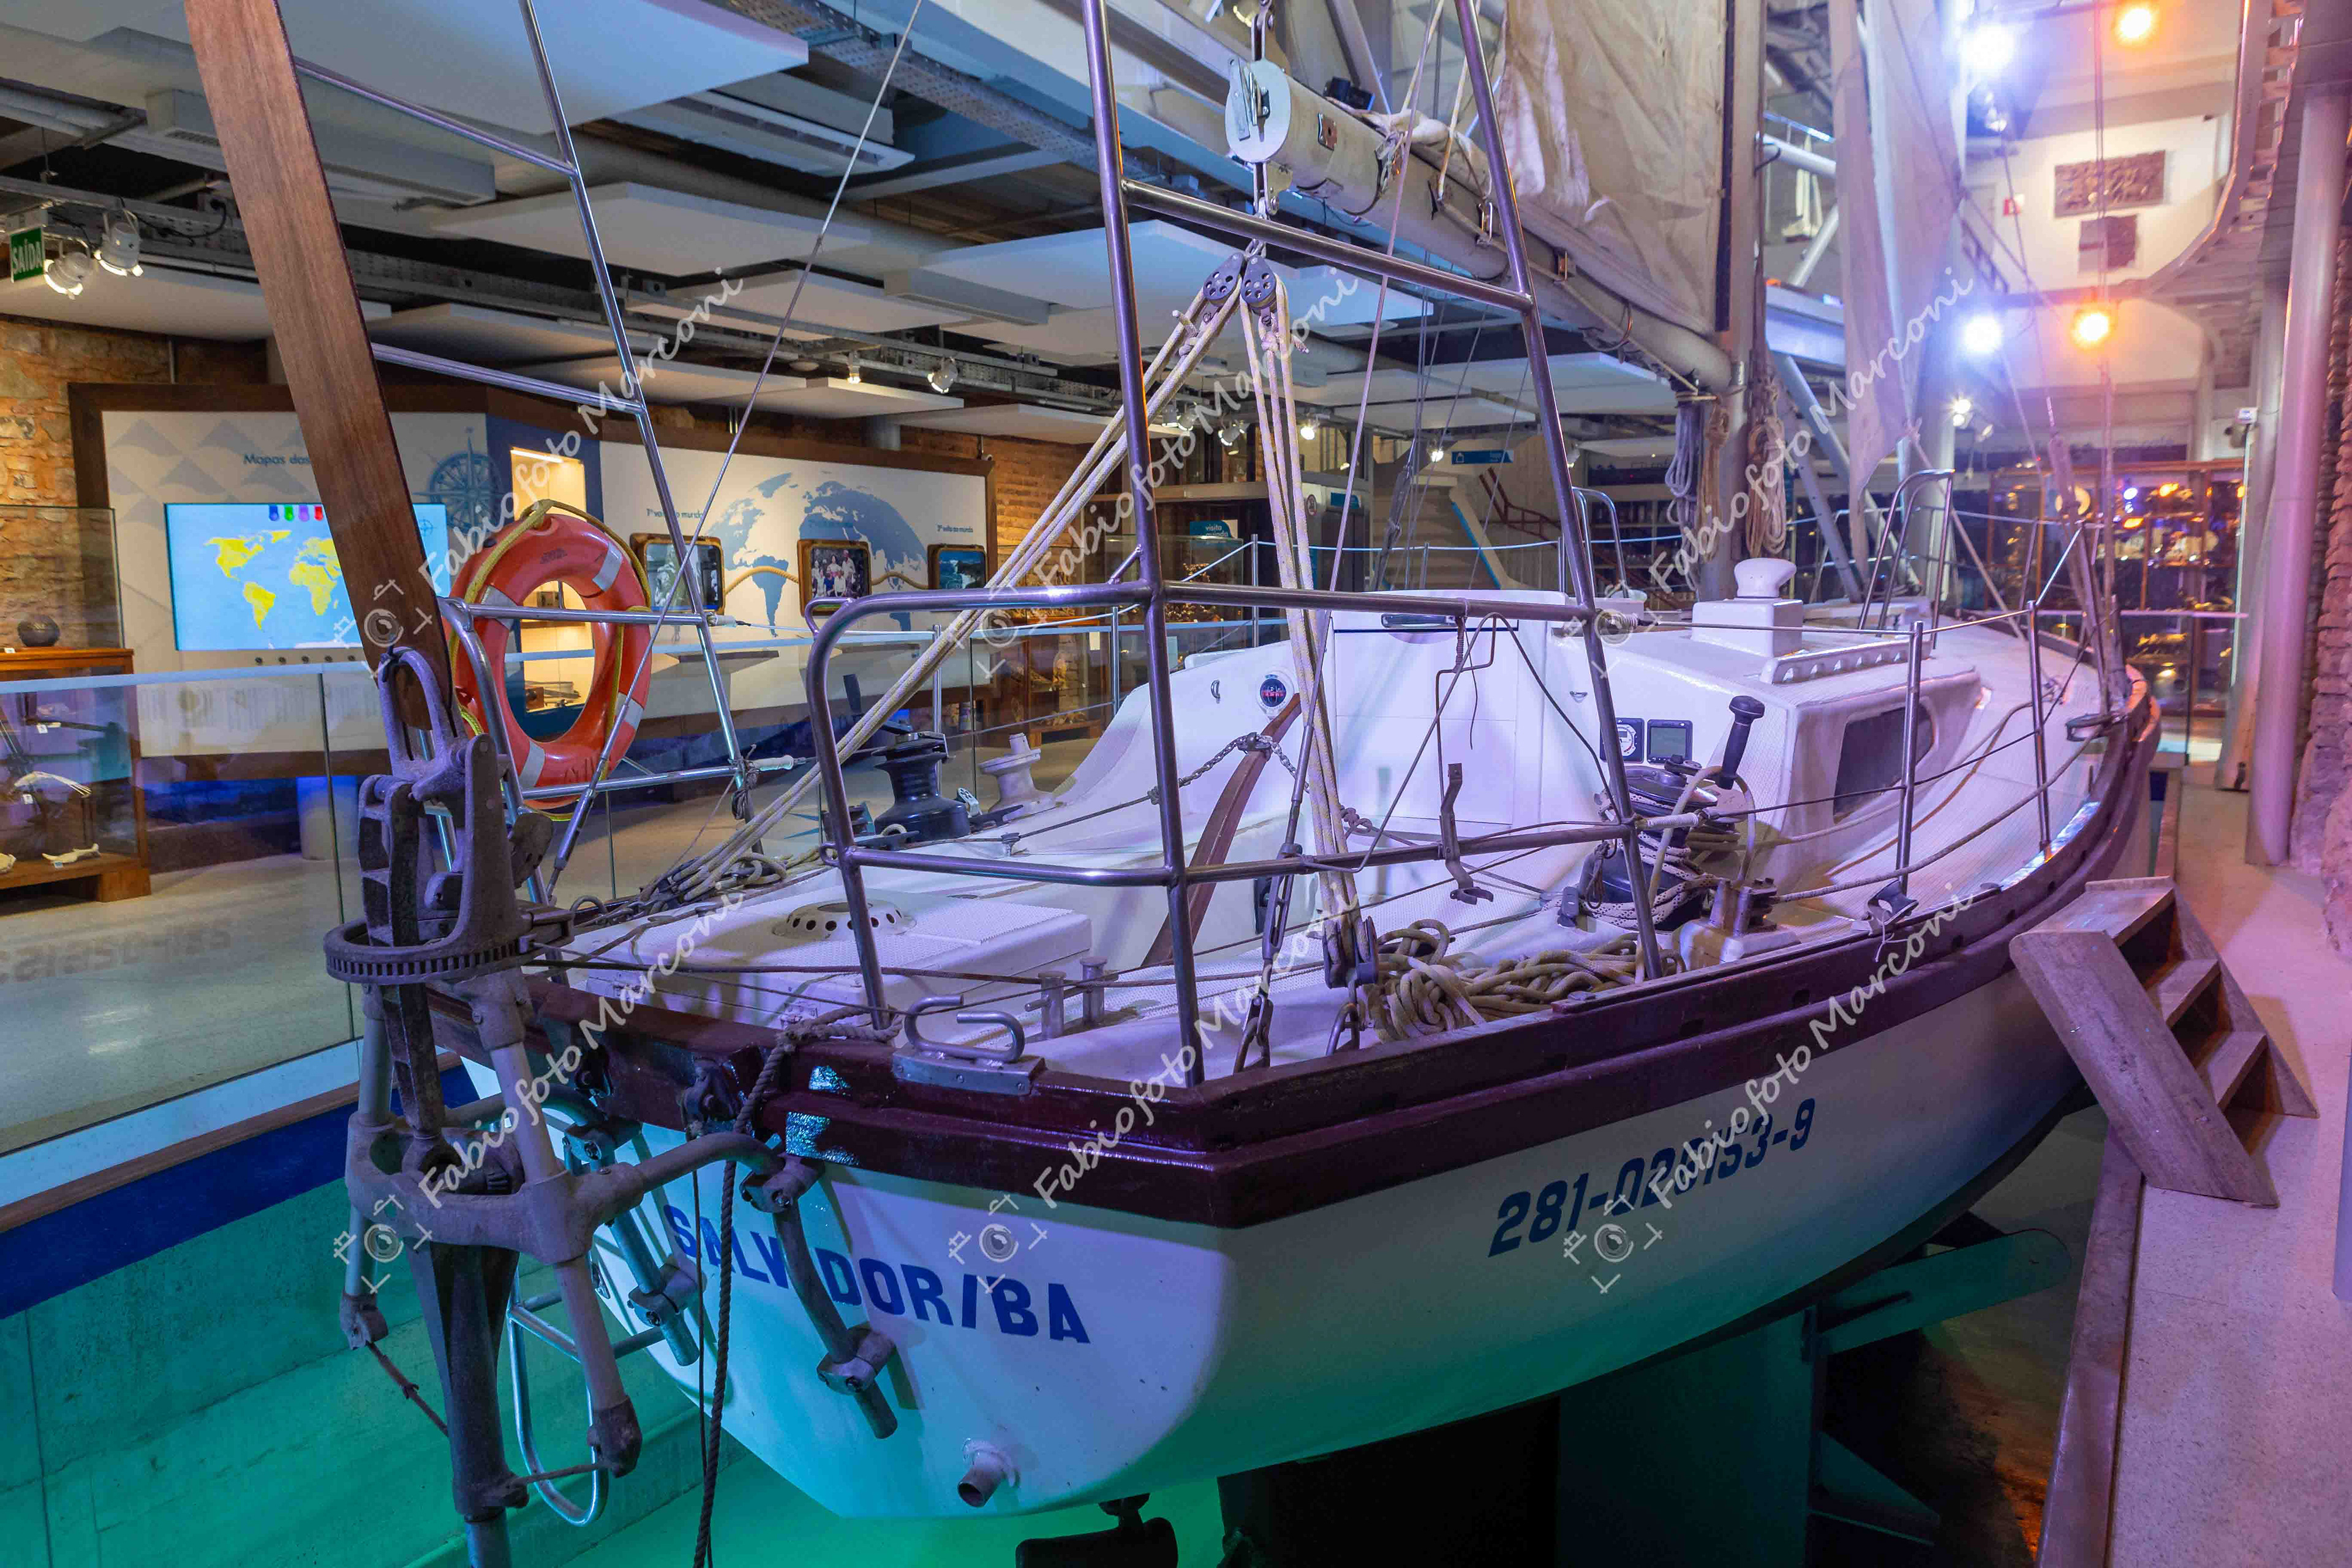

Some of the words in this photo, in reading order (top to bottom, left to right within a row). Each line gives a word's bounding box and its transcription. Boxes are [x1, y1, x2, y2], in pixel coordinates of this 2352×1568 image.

[13, 238, 42, 274] SAÍDA
[244, 453, 285, 467] Mapas
[663, 1204, 1091, 1344] SALVDOR/BA
